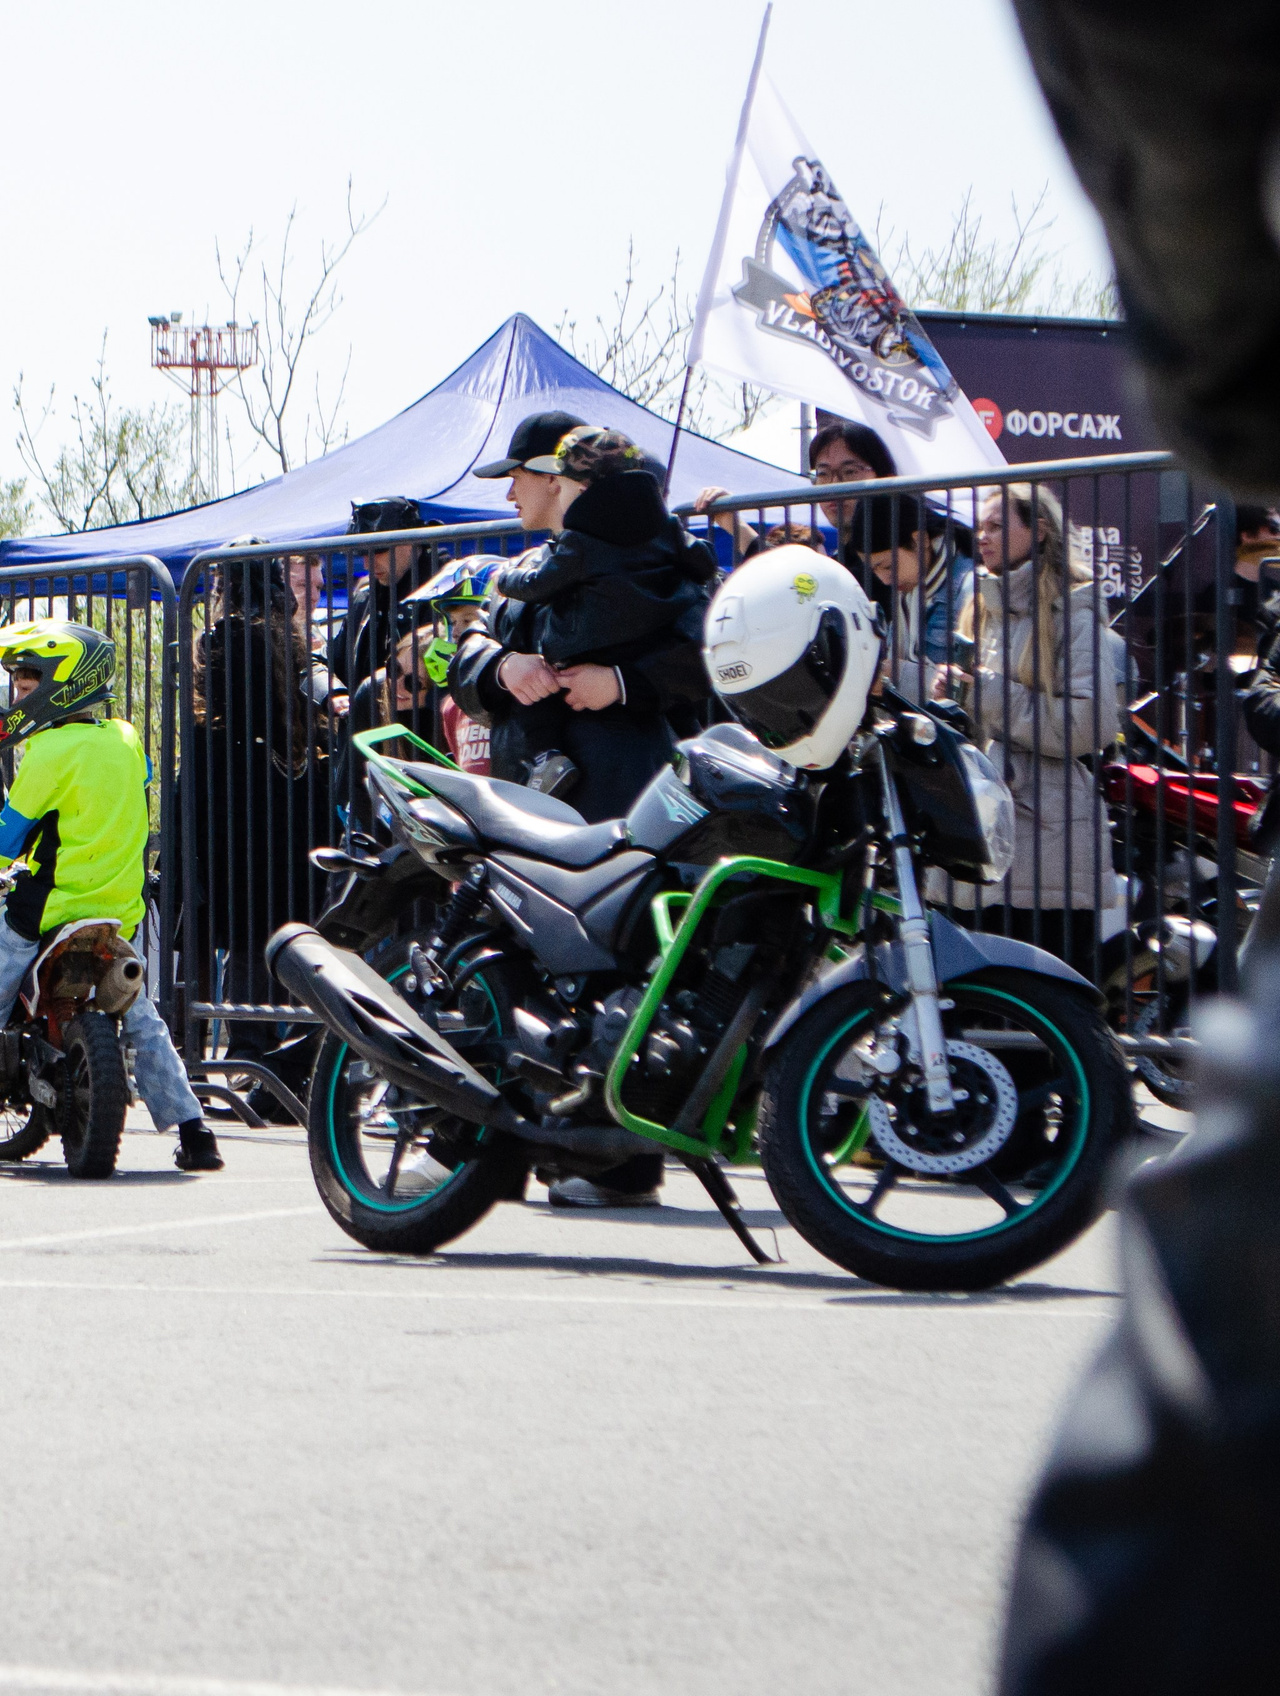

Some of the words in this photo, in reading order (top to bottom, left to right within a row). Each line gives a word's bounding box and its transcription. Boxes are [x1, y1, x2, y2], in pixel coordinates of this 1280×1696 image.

[767, 300, 937, 410] VLADIVOSTOK
[1006, 408, 1122, 440] ФОРСАЖ
[717, 664, 748, 681] SHOEI
